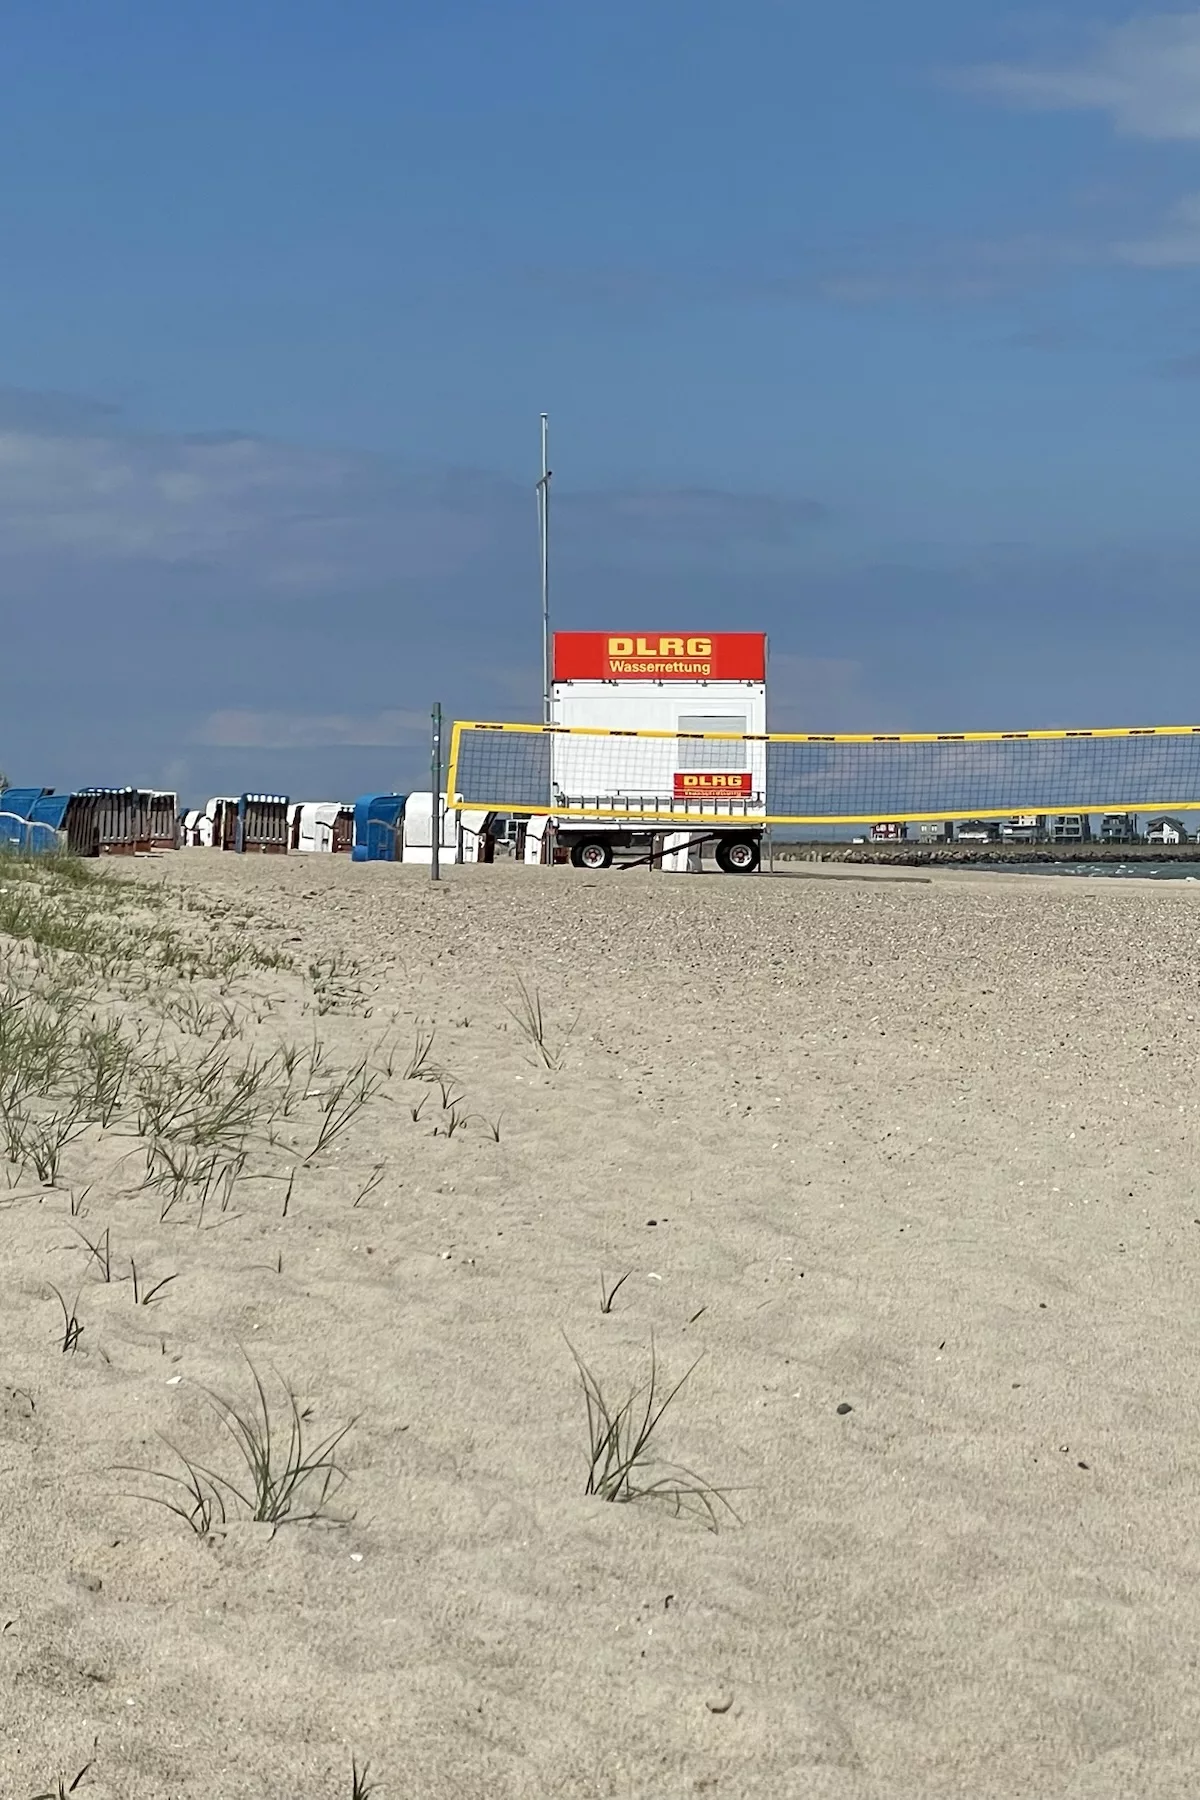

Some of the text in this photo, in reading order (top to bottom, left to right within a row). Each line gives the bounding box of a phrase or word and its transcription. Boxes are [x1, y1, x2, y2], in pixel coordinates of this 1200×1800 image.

[608, 637, 712, 656] DLRG
[609, 660, 711, 675] Wasserrettung
[683, 774, 742, 786] DLRG
